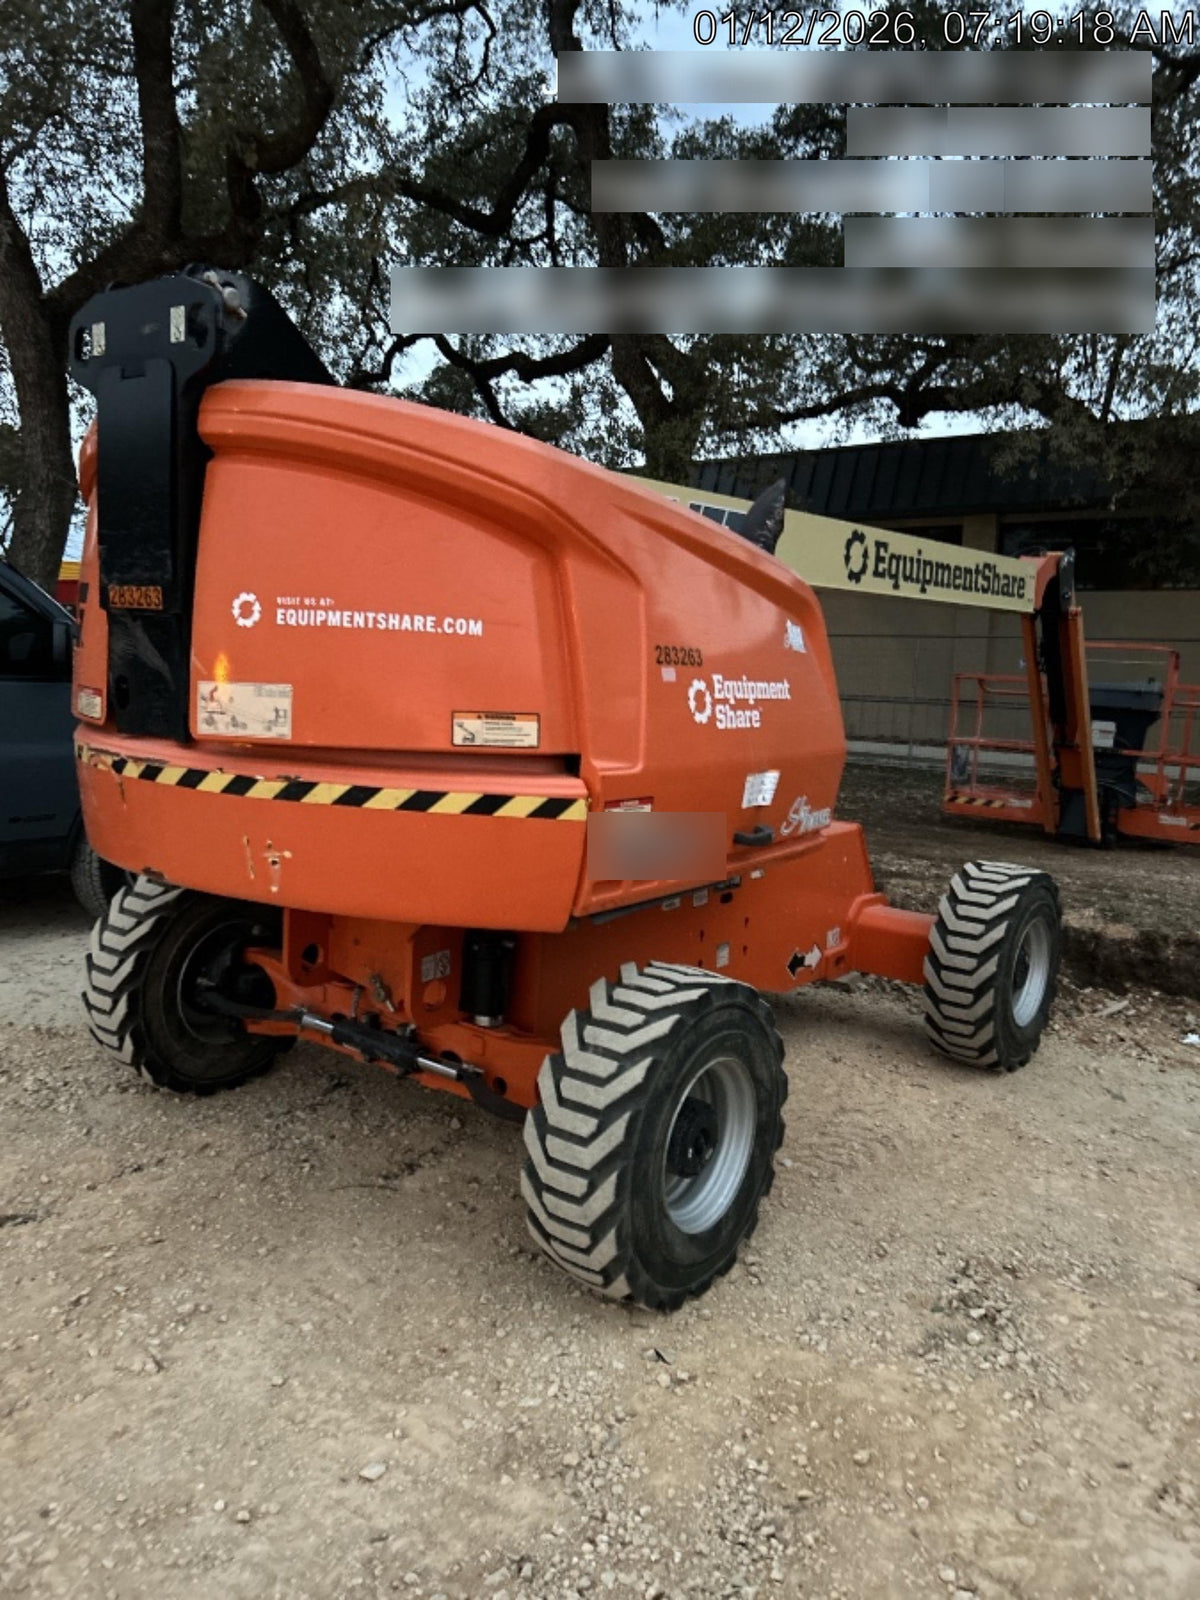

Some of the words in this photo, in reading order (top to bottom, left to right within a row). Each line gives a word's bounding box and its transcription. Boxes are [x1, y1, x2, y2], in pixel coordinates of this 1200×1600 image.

[872, 540, 1026, 601] EquipmentShare
[109, 586, 163, 607] 283263
[276, 608, 483, 637] EQUIPMENTSHARE.COM
[655, 645, 703, 667] 283263
[712, 674, 791, 704] Equipment
[715, 703, 762, 730] Share
